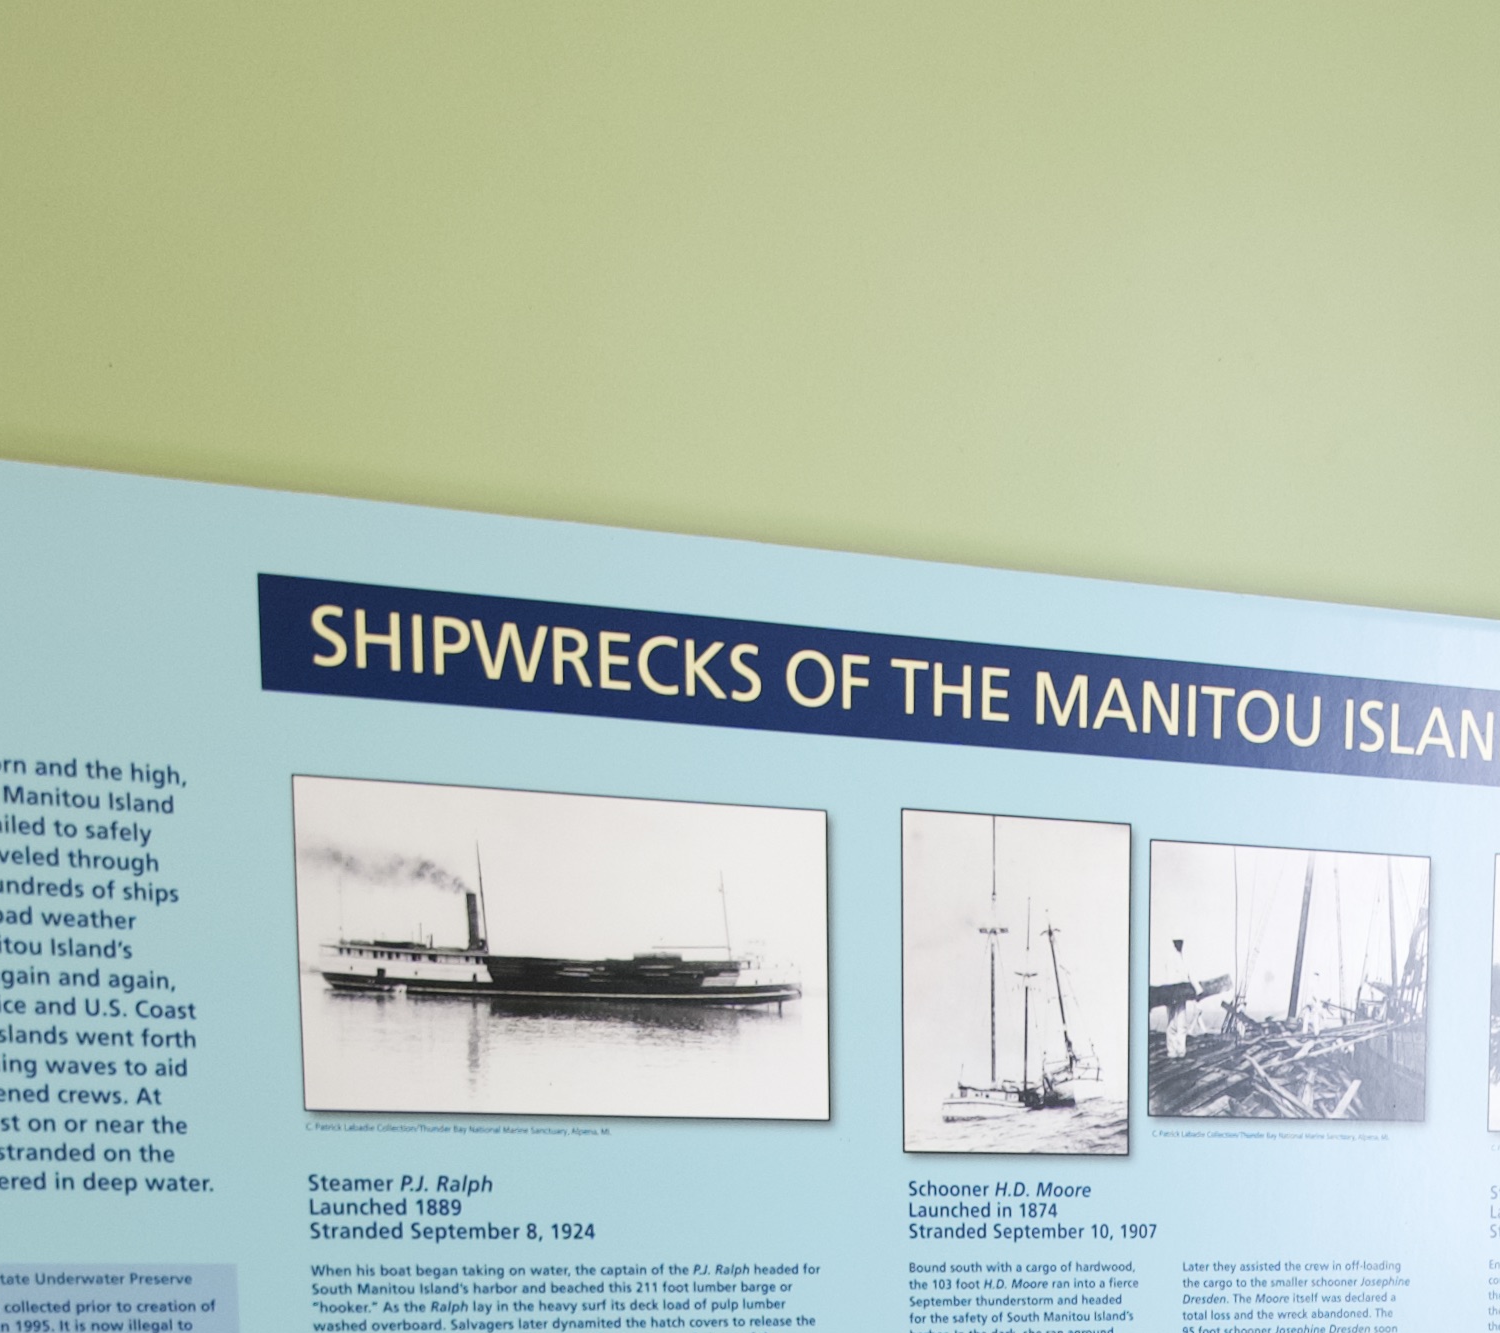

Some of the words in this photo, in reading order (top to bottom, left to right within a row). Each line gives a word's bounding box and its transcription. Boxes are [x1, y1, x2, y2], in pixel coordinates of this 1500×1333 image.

[311, 604, 762, 702] SHIPWRECKS
[785, 649, 870, 710] OF
[890, 658, 1010, 722] THE
[1035, 671, 1321, 747] MANITOU
[34, 757, 78, 778] and
[84, 759, 123, 782] the
[130, 762, 187, 790] high,
[2, 784, 101, 810] Manitou
[108, 791, 175, 815] Island
[308, 1173, 394, 1192] Steamer
[400, 1174, 429, 1193] P.J.
[436, 1174, 493, 1197] Ralph
[908, 1179, 990, 1197] Schooner
[994, 1181, 1030, 1197] H.D.
[1036, 1181, 1092, 1198] Moore
[309, 1197, 407, 1216] Launched
[415, 1198, 462, 1217] 1889
[909, 1201, 991, 1219] Launched
[997, 1201, 1012, 1218] in
[1019, 1202, 1058, 1219] 1874
[310, 1221, 404, 1240] Stranded
[410, 1221, 520, 1244] September
[526, 1222, 543, 1242] 8,
[551, 1222, 596, 1240] 1924
[908, 1222, 987, 1240] Stranded
[993, 1222, 1085, 1243] September
[1091, 1223, 1114, 1241] 10,
[1120, 1223, 1157, 1239] 1907
[34, 1271, 125, 1286] Underwater
[129, 1272, 193, 1286] Preserve
